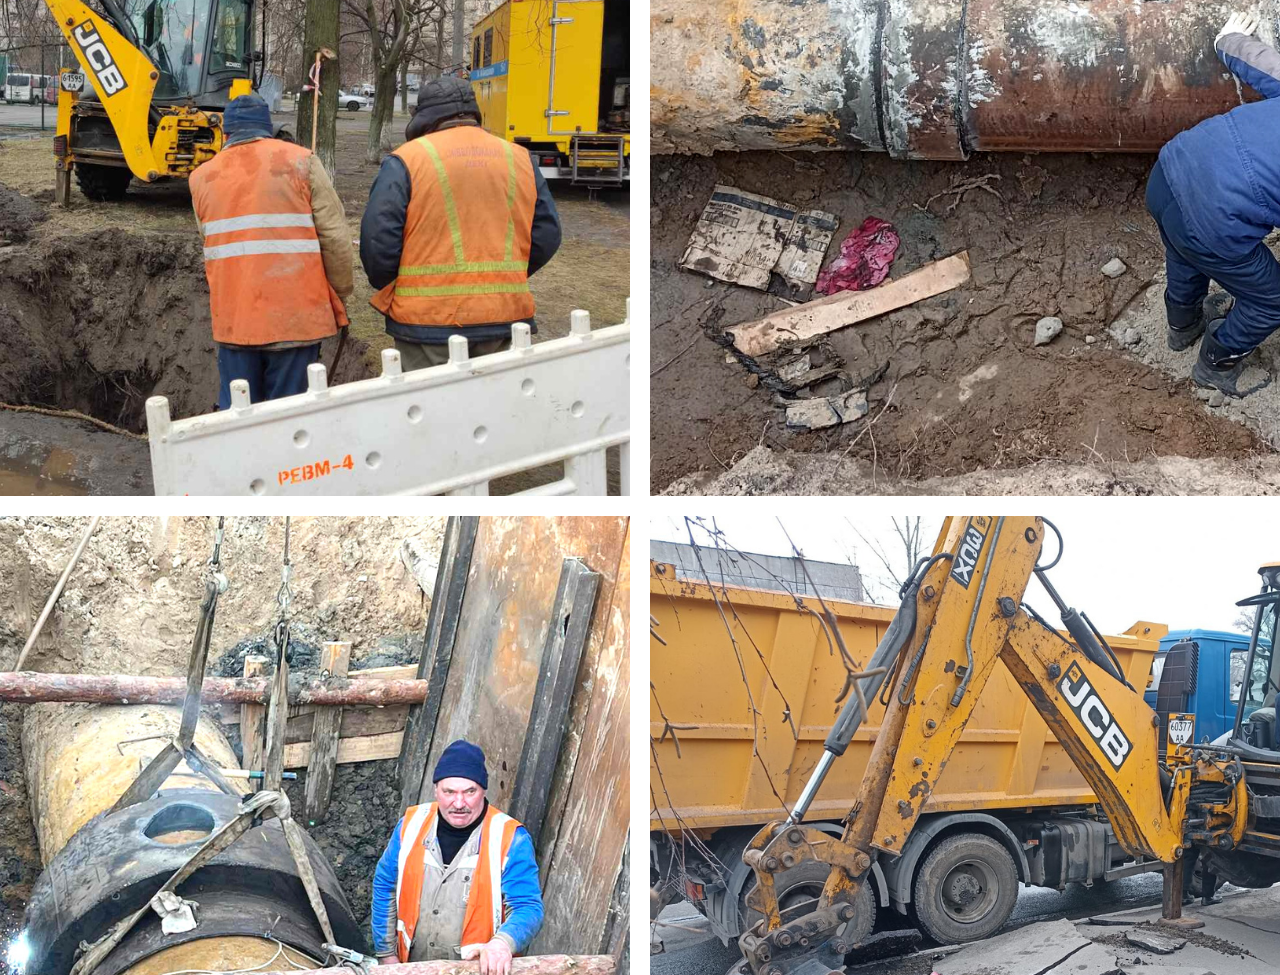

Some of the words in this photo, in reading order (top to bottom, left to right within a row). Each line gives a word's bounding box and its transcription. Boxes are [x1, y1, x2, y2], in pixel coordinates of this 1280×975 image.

[74, 26, 124, 94] JCB
[953, 527, 983, 583] 3CX
[1061, 677, 1129, 766] JCB
[1170, 721, 1192, 731] 60377
